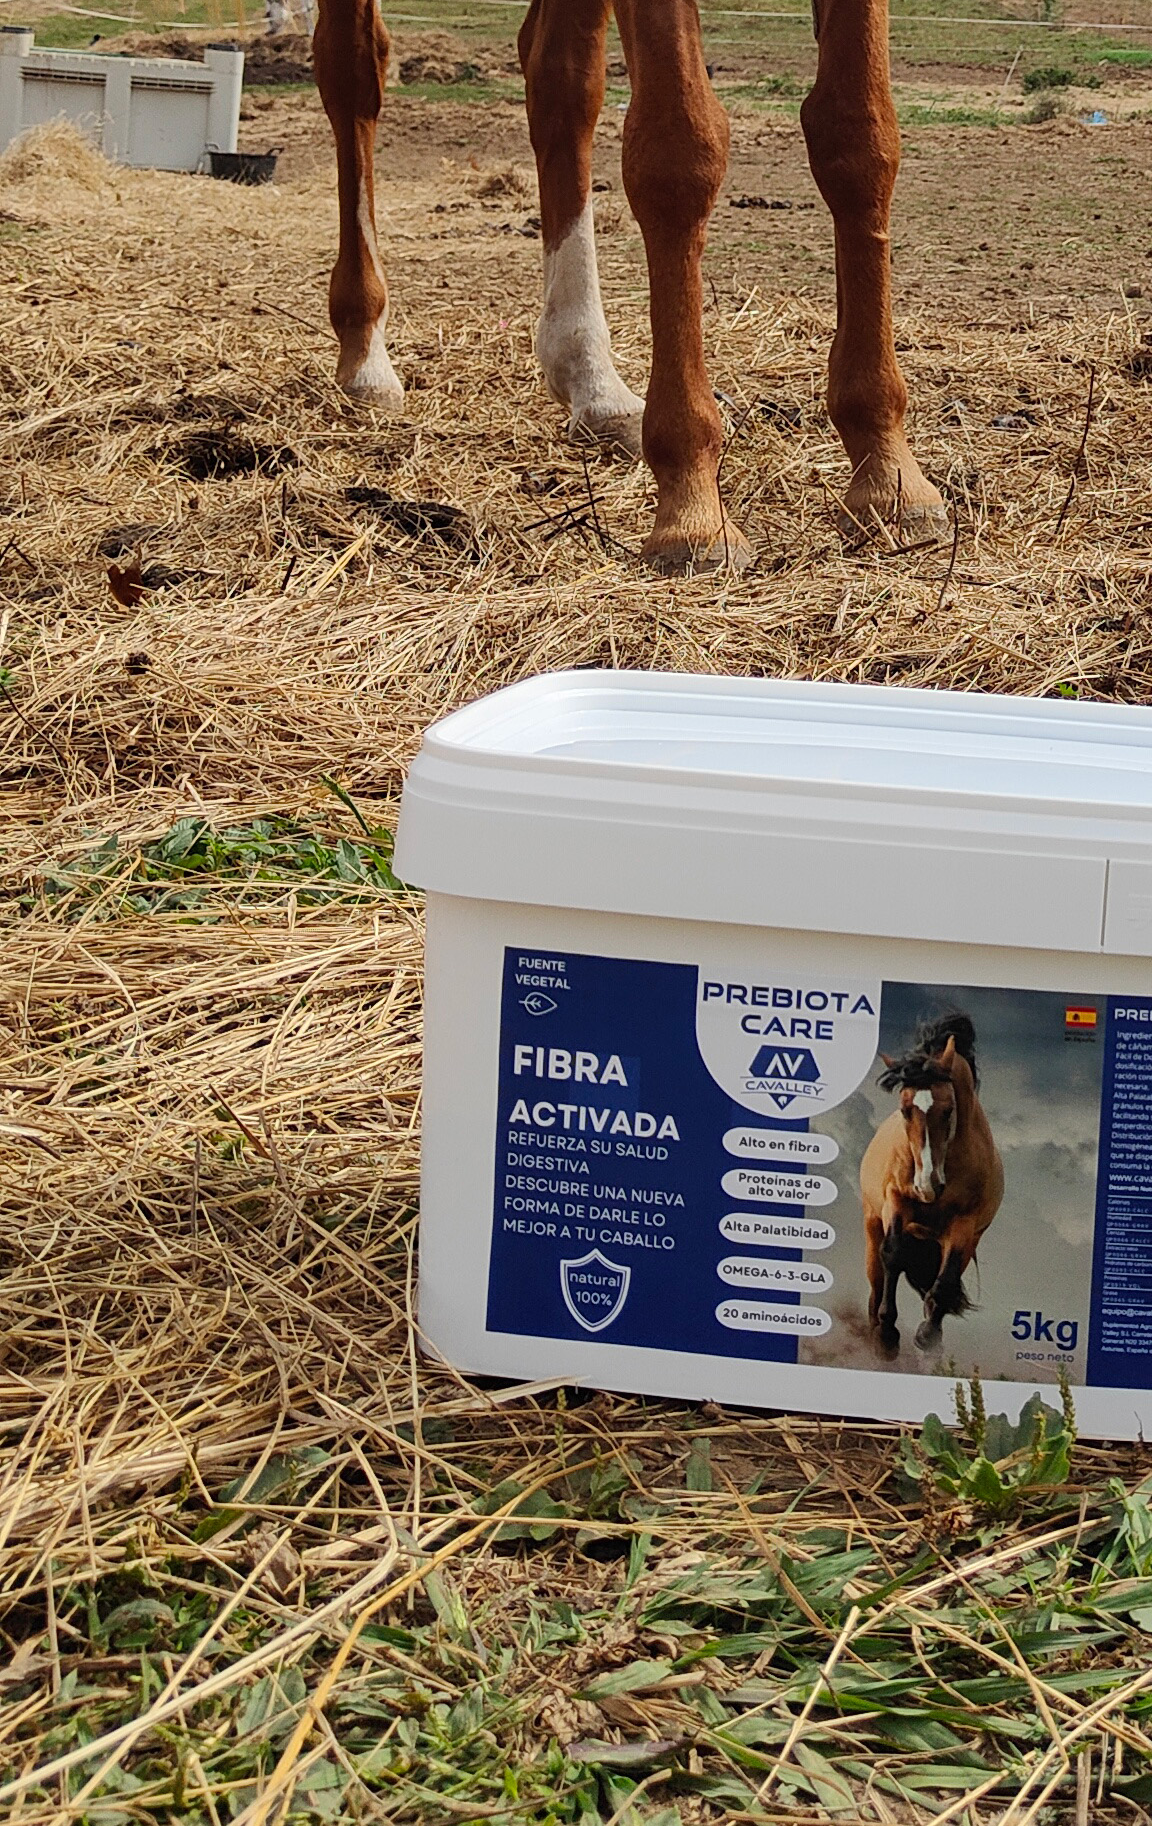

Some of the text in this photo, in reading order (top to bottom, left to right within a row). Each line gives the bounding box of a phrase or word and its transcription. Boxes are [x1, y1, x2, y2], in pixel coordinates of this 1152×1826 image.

[518, 957, 566, 972] FUENTE
[515, 973, 571, 989] VEGETAL
[702, 981, 875, 1015] PREBIOTA
[740, 1014, 834, 1041] CARE
[513, 1044, 628, 1087] FIBRA
[745, 1080, 826, 1096] CAVALLEY
[508, 1099, 680, 1139] ACTIVADA
[508, 1130, 669, 1160] REFUERZA SU SALUD
[738, 1136, 820, 1153] Alto en fibra
[507, 1152, 590, 1175] DIGESTIVA
[505, 1174, 685, 1207] DESCUBRE UNA NUEVA
[738, 1172, 821, 1190] Proteínas de
[748, 1185, 811, 1200] alto valor
[504, 1196, 666, 1226] FORMA DE DARLE LO
[503, 1218, 675, 1250] MEJOR A TU CABALLO
[723, 1220, 750, 1233] Alta
[569, 1273, 621, 1287] natural
[722, 1264, 826, 1284] OMEGA-6-3-GLA
[575, 1291, 613, 1306] 100%
[723, 1307, 822, 1327] 20 aminoácidos
[1011, 1310, 1079, 1352] 5kg
[1015, 1351, 1075, 1363] peso neto
